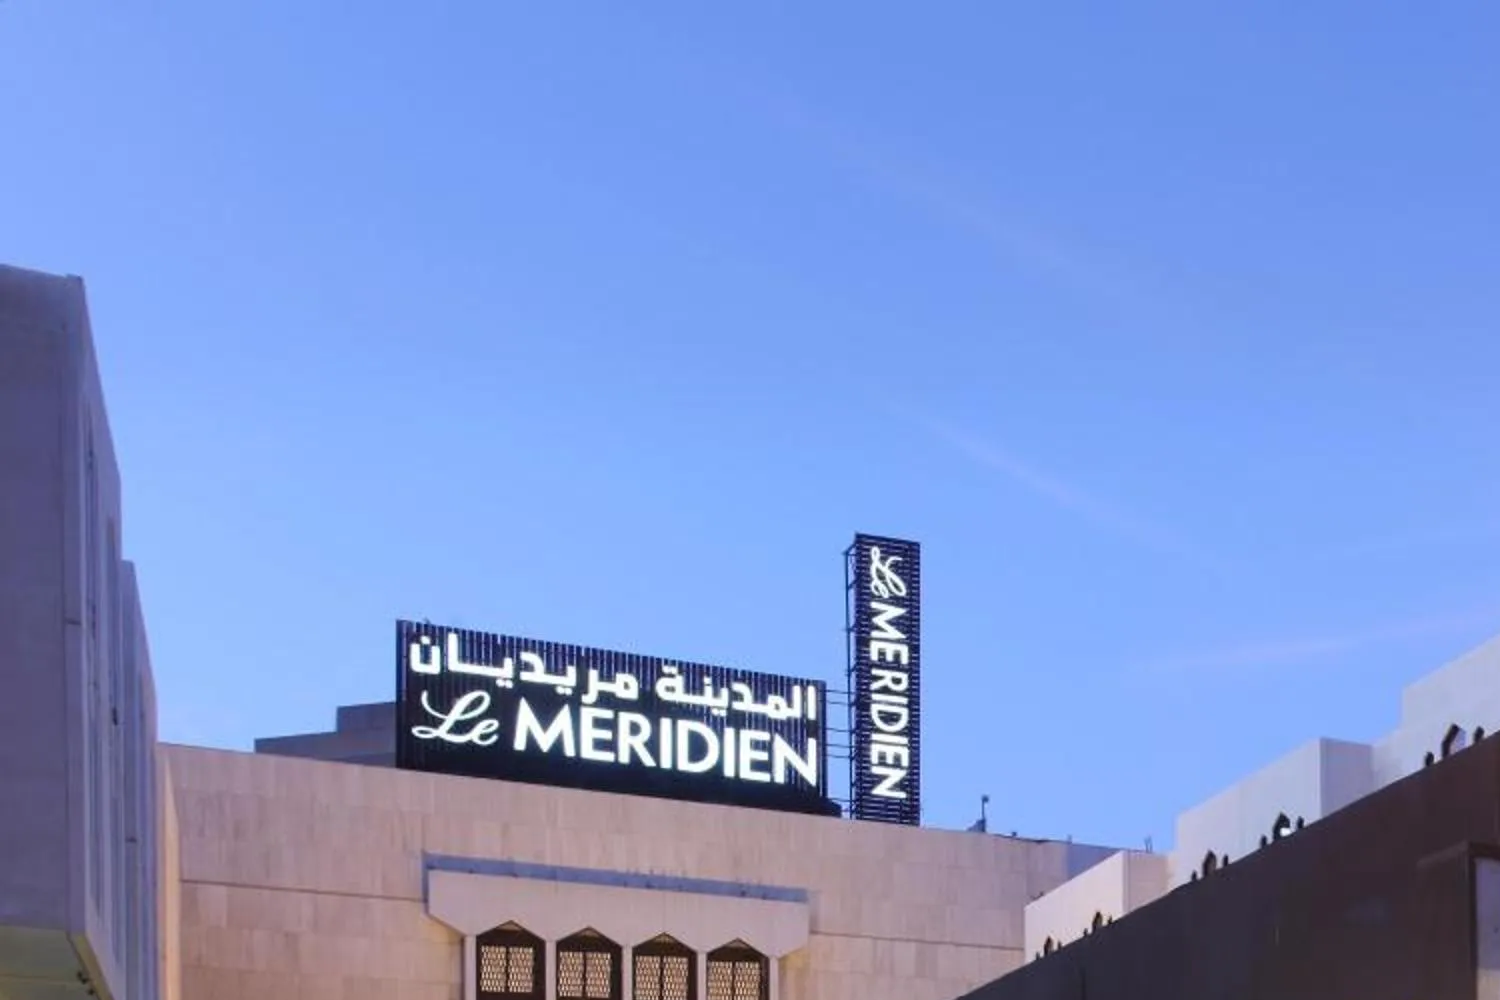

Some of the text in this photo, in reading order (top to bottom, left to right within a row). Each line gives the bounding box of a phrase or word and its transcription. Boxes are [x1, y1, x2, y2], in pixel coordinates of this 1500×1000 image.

[410, 632, 817, 721] المدينة مريديان
[869, 546, 910, 799] Le MERIDIEN
[411, 690, 817, 787] Le MERIDIEN
